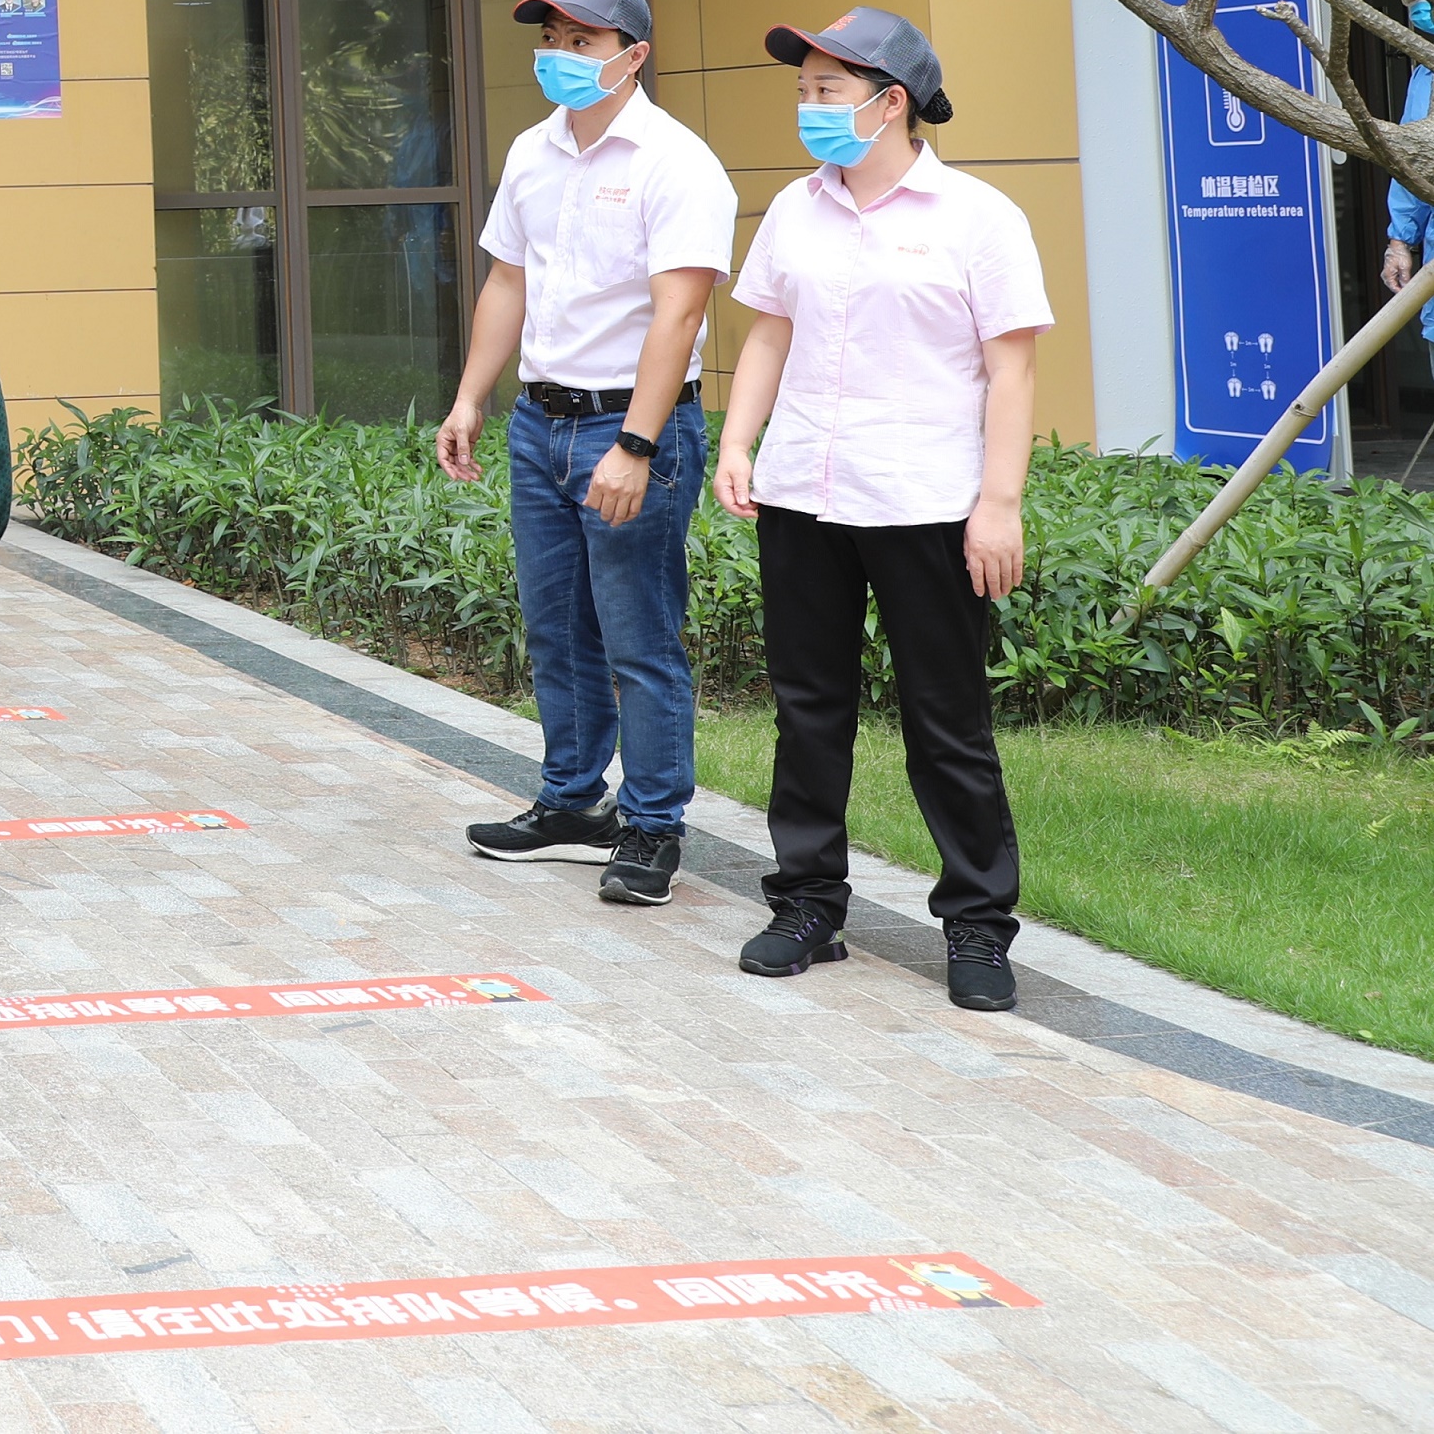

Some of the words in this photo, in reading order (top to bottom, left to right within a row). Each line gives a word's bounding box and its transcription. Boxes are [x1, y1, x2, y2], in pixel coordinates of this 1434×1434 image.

[1200, 174, 1280, 200] 体温复检区
[1181, 203, 1245, 221] Temperature
[1246, 203, 1278, 219] retest
[1279, 205, 1304, 218] area
